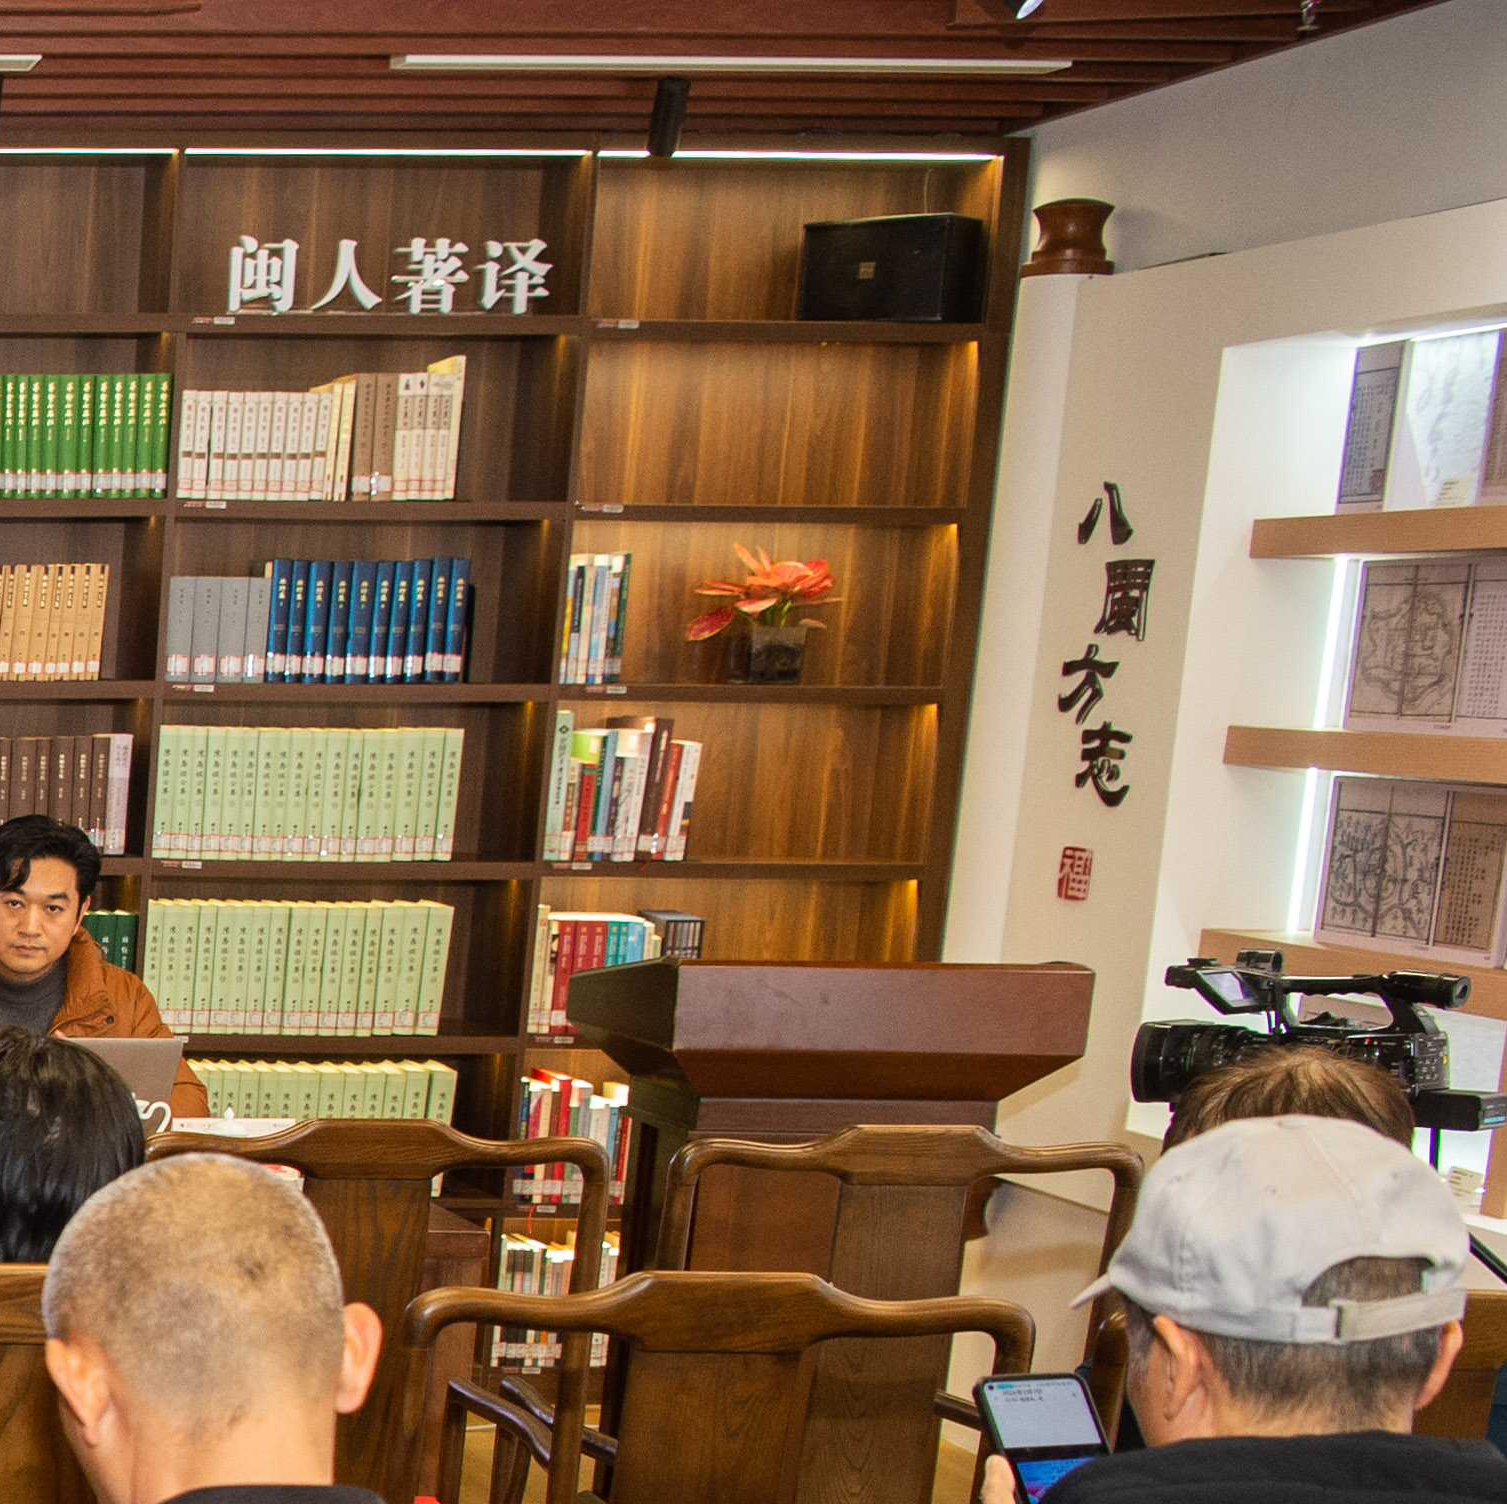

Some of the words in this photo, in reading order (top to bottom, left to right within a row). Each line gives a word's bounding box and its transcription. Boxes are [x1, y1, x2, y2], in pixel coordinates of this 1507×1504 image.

[229, 235, 554, 316] 闽人著译
[1058, 847, 1093, 900] 福
